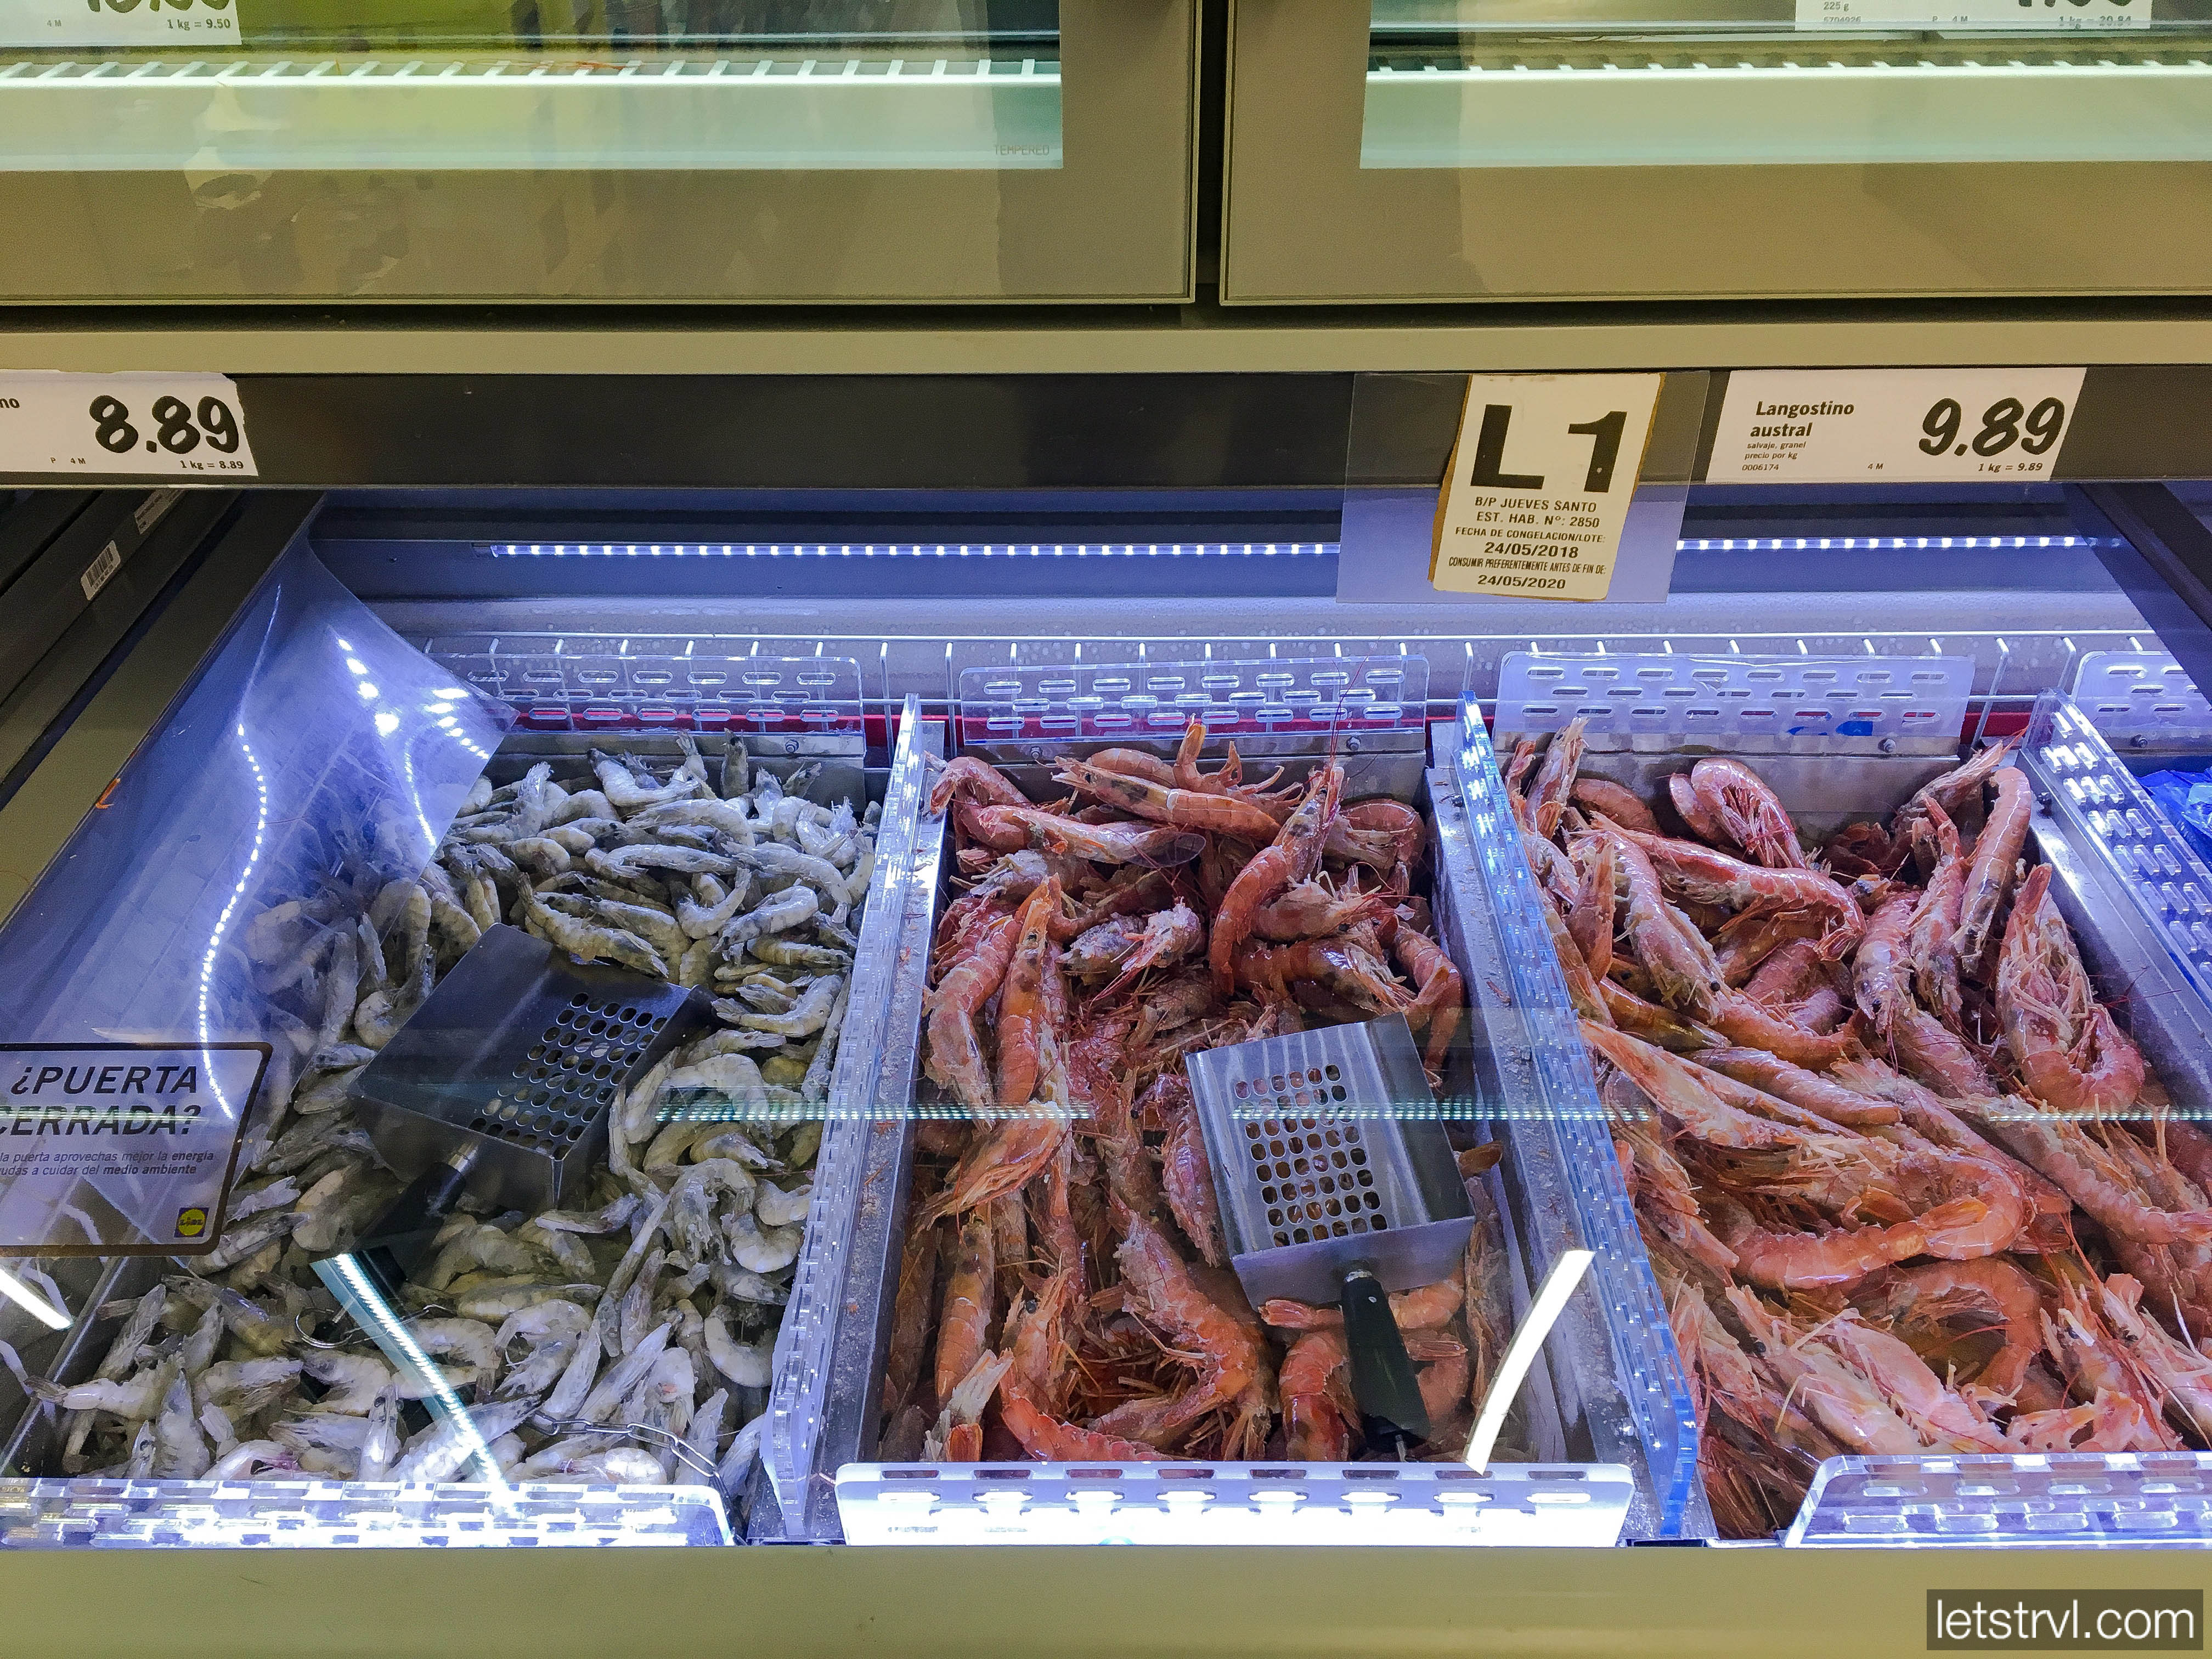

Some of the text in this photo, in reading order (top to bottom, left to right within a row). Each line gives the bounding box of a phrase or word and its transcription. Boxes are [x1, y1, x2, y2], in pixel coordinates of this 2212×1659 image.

[1823, 0, 1840, 10] 225
[167, 19, 173, 29] 1
[177, 18, 190, 31] kg
[206, 18, 230, 29] 9.50
[995, 145, 1049, 156] TEMPERED
[1756, 400, 1854, 419] Langostino
[89, 395, 239, 454] 8.89
[1750, 422, 1813, 437] austral
[1918, 397, 2065, 456] 9.89
[1470, 404, 1628, 493] L 1
[1780, 441, 1806, 450] granel
[1788, 452, 1798, 460] kg
[191, 460, 204, 470] kg
[219, 461, 244, 469] 8.89
[1978, 463, 1984, 471] 1
[1988, 463, 2001, 473] kg
[2017, 462, 2043, 471] 9.89
[1475, 496, 1596, 512] B/P JUEVES SANTO
[1477, 512, 1504, 523] EST.
[1509, 514, 1539, 524] HAB.
[1570, 516, 1600, 527] 2850
[1455, 527, 1606, 543] FECHA DE CONGELACION/LOTE:
[1485, 542, 1579, 558] 24/05/2018
[1449, 557, 1483, 567] CONSUMIR
[1486, 558, 1547, 572] PREFERENTEMENTE
[1550, 562, 1570, 572] ANTES
[1572, 563, 1581, 573] DE
[1583, 564, 1594, 574] FIN
[1478, 574, 1566, 589] 24/05/2020
[11, 1066, 196, 1094] ¿PUERTA
[13, 1153, 49, 1163] puerta
[54, 1152, 117, 1163] aprovechas
[122, 1153, 154, 1164] mejor
[172, 1152, 214, 1164] energía
[0, 1165, 28, 1176] udas
[42, 1165, 78, 1175] cuidar
[82, 1165, 99, 1175] del
[103, 1165, 137, 1175] medio
[142, 1165, 196, 1175] ambiente
